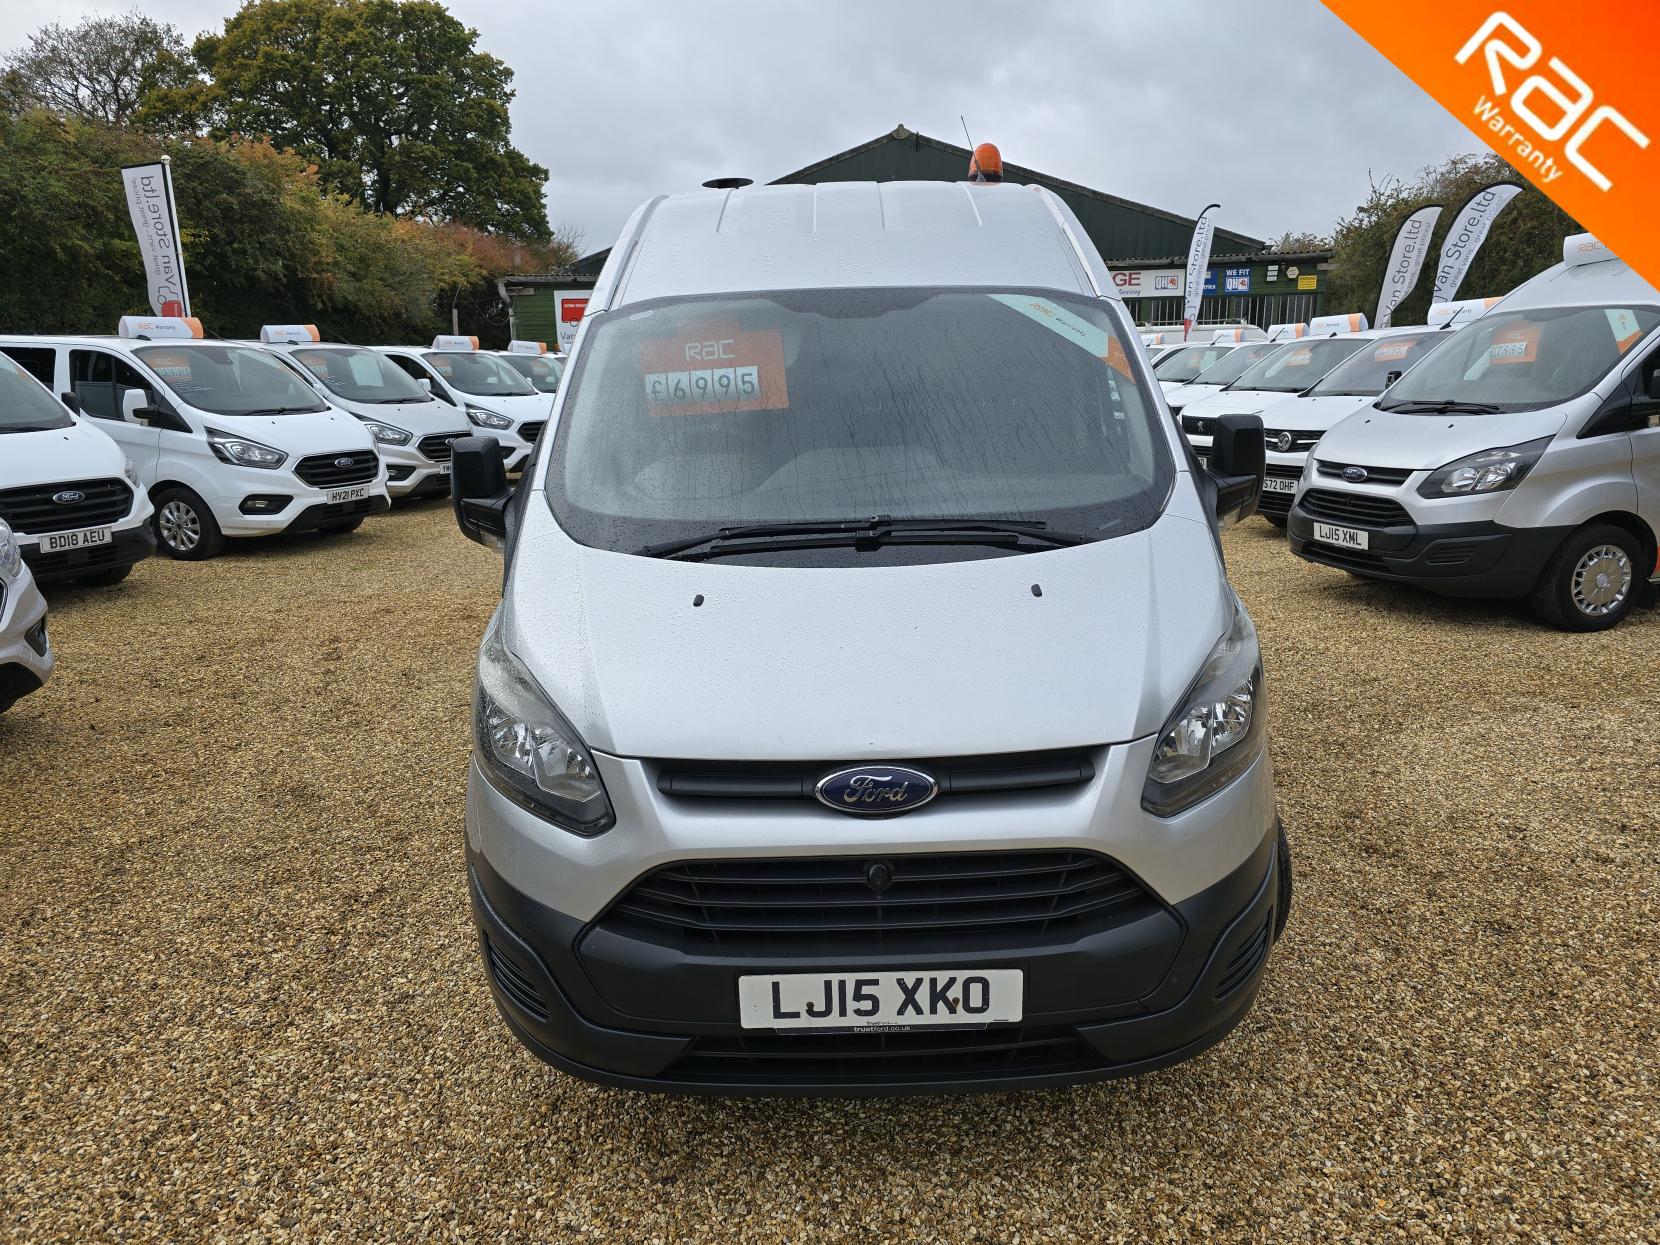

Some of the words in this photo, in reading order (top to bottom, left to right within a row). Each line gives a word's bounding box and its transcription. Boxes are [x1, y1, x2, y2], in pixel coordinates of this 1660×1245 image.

[1446, 190, 1497, 261] Store.ltd
[1189, 216, 1207, 276] Store.ltd
[1450, 267, 1464, 288] great
[1474, 223, 1488, 243] great
[1414, 248, 1424, 266] great
[1383, 290, 1401, 318] Van
[1392, 219, 1422, 286] Store.ltd
[1113, 272, 1141, 287] GE
[1055, 317, 1087, 337] Warranty
[651, 373, 755, 402] £6995
[350, 487, 364, 498] PXC
[1263, 478, 1278, 490] S72
[61, 492, 79, 501] Ford
[49, 534, 79, 549] BD18
[83, 530, 105, 545] AEU
[1319, 525, 1340, 542] LJ15
[1342, 531, 1362, 546] XML
[843, 775, 909, 803] Ford
[771, 979, 880, 1020] LJ15
[895, 976, 990, 1016] XKO
